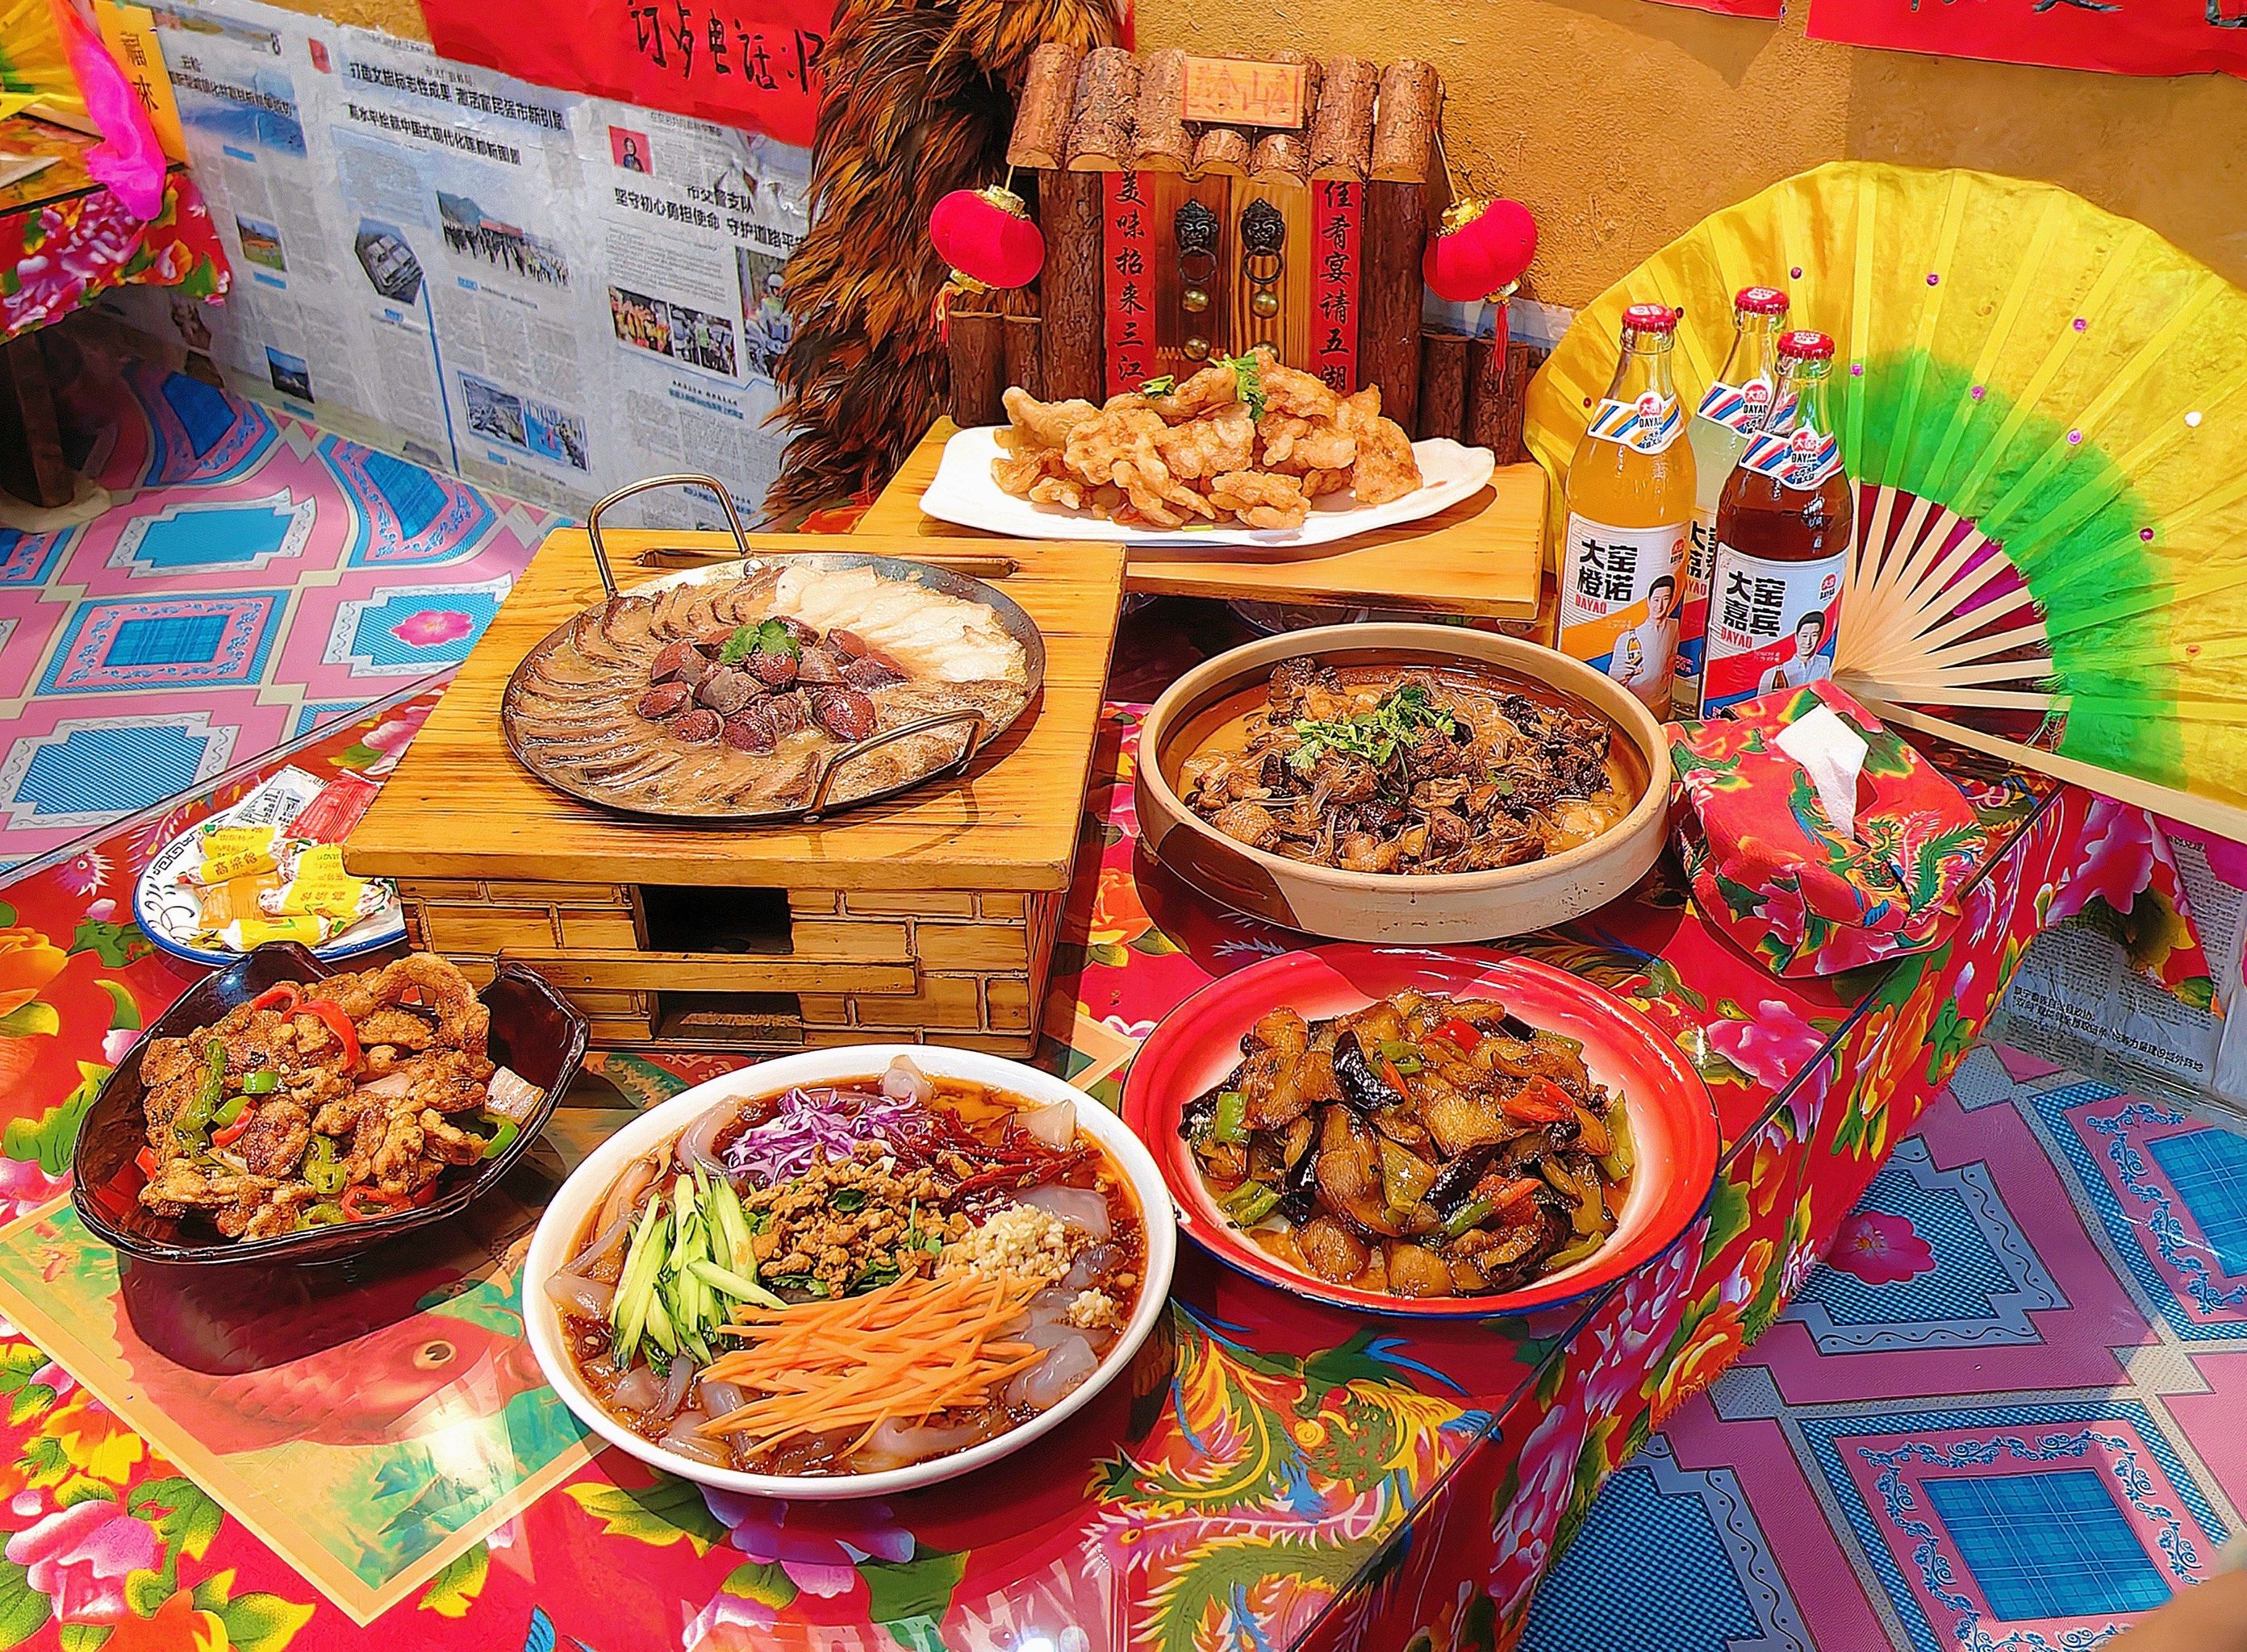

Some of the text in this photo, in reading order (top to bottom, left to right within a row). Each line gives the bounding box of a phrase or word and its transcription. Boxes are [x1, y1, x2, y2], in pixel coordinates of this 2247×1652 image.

[615, 188, 720, 231] 坚守初心勇担使命
[1114, 165, 1147, 394] 美味招来三江
[1577, 565, 1634, 603] 橙诺
[1576, 594, 1608, 615] DAYAO
[1723, 597, 1781, 637] 嘉宾
[1720, 627, 1753, 649] DAYAO
